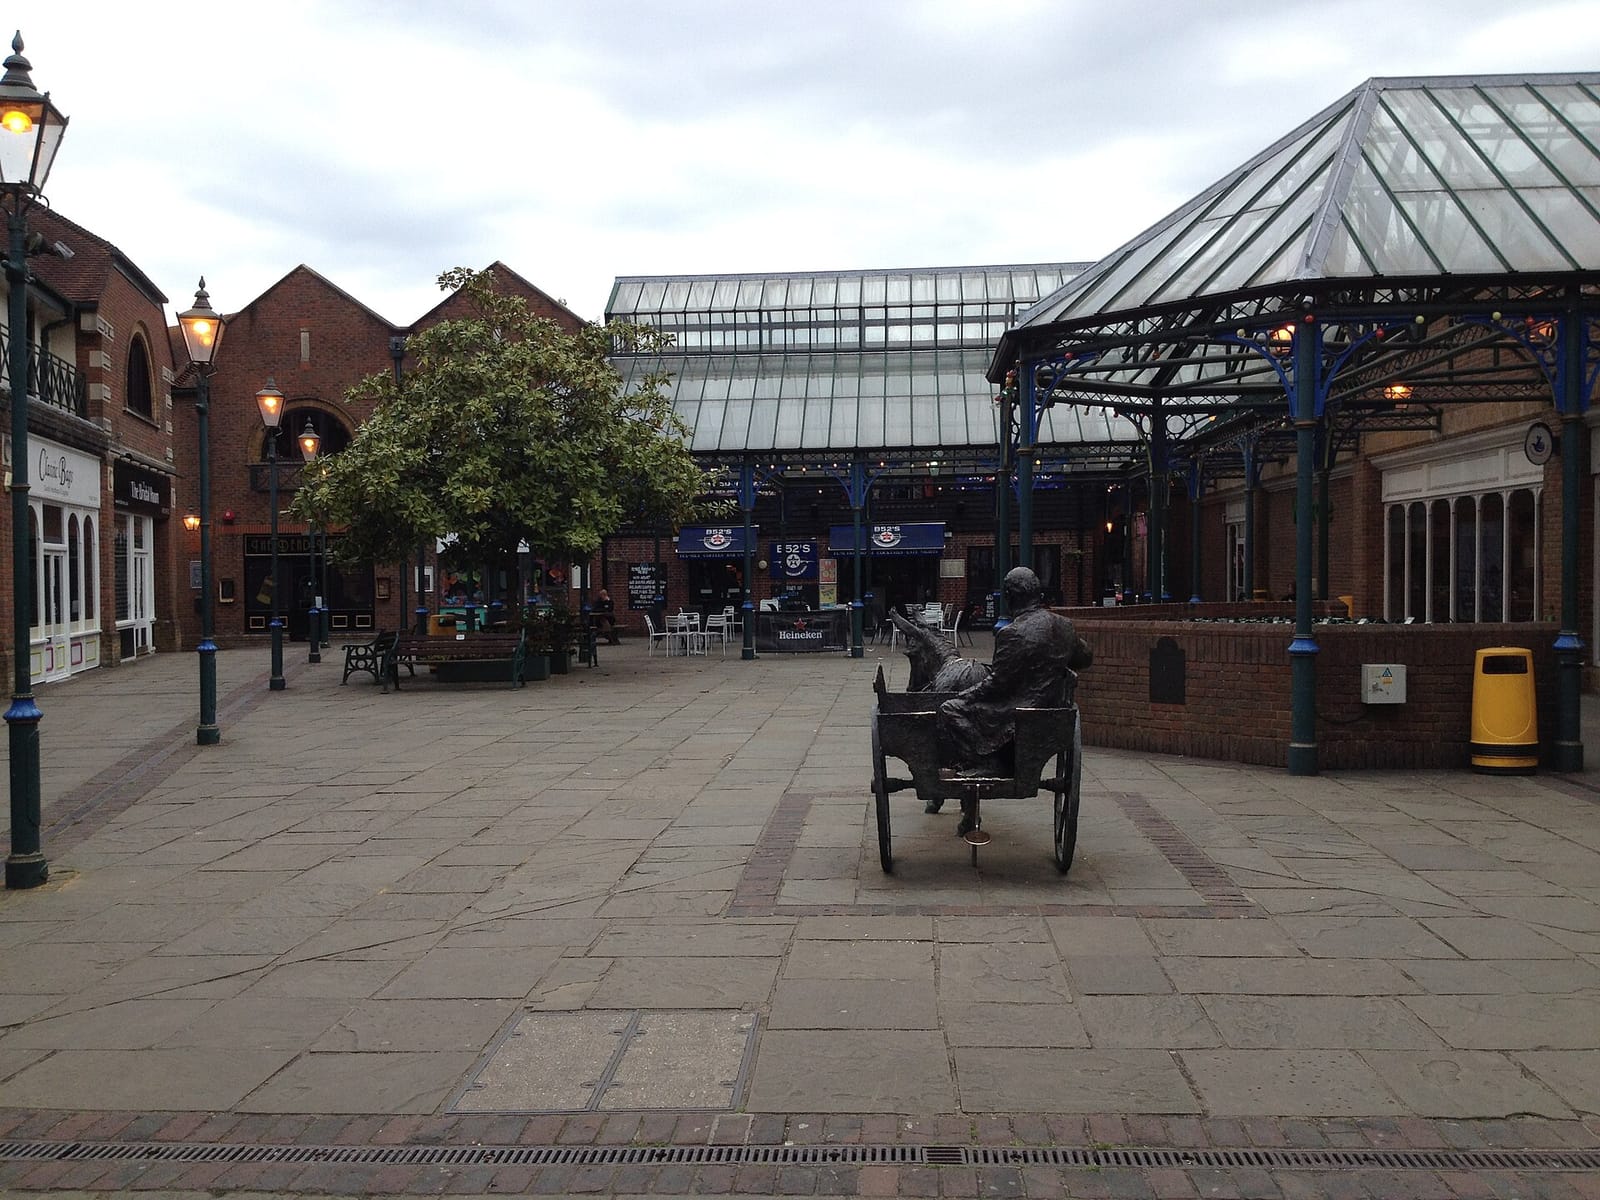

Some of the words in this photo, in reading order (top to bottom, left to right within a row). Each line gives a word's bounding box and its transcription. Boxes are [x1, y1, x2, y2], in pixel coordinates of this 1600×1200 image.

[59, 456, 74, 489] Bags
[130, 480, 139, 500] The
[778, 630, 823, 640] Heineken
